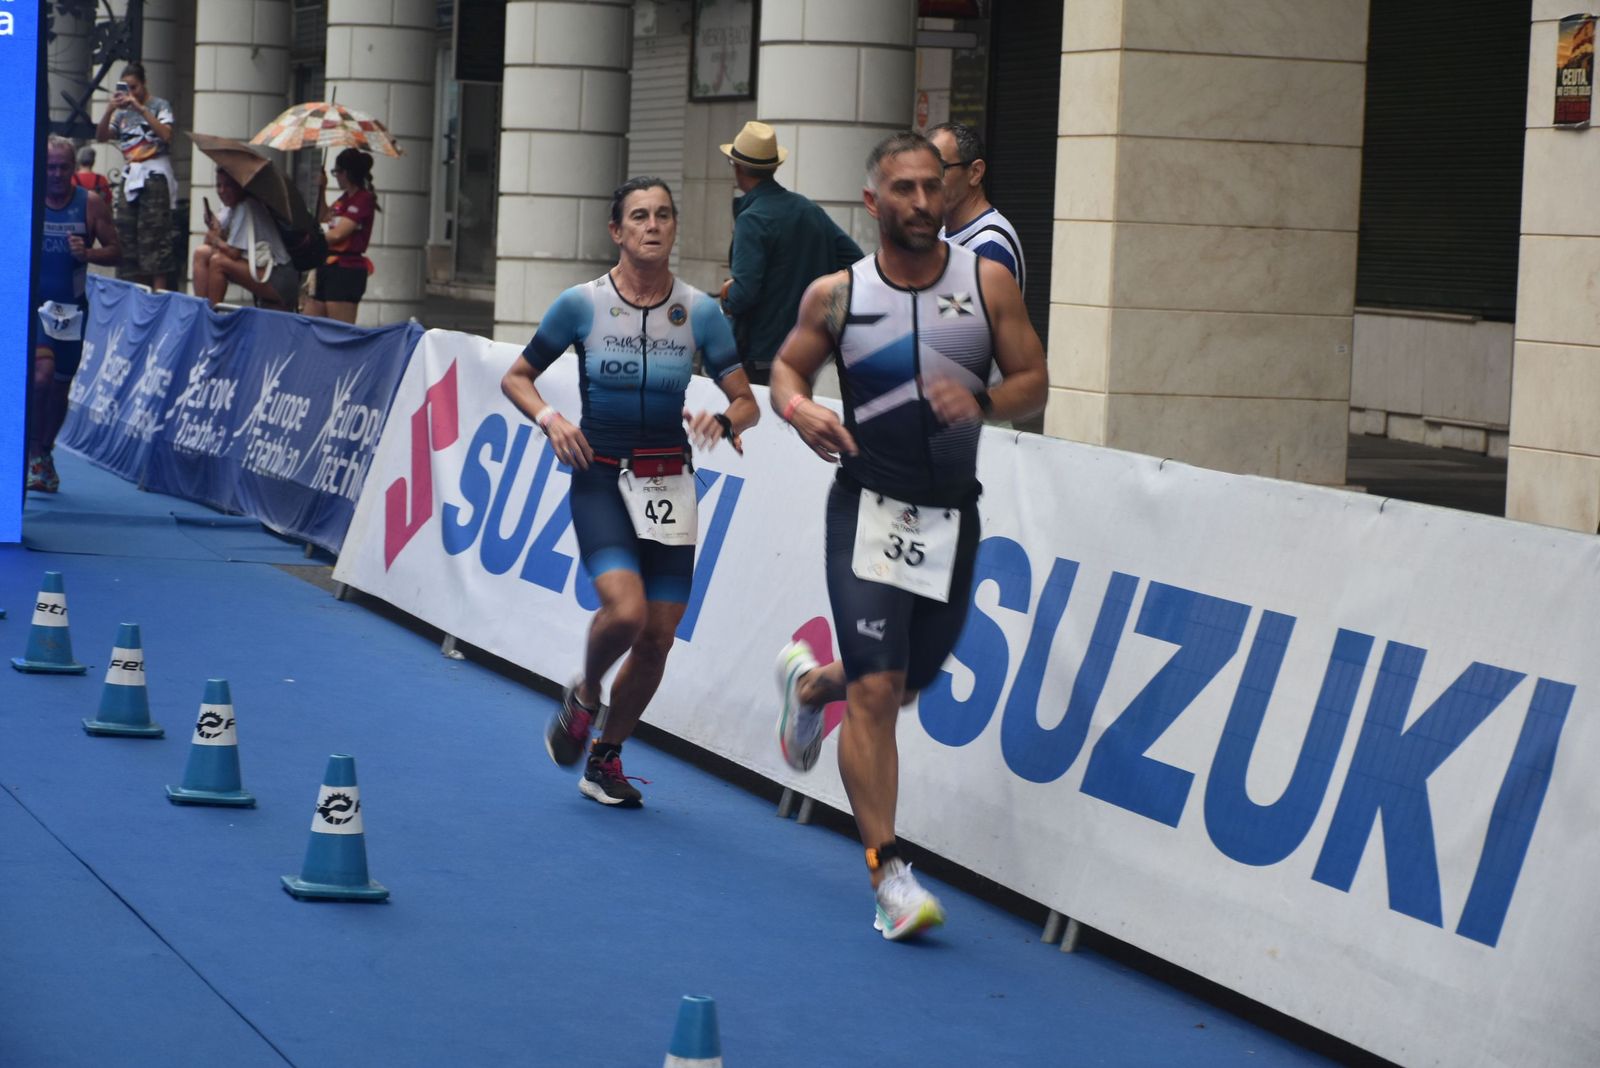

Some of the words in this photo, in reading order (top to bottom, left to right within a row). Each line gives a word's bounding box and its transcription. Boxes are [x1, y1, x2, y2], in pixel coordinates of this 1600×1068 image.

[600, 360, 640, 375] IOC
[260, 379, 311, 434] Europe
[328, 392, 384, 452] Europ
[441, 413, 745, 643] SUZI
[645, 499, 676, 524] 42
[884, 533, 925, 567] 35
[918, 536, 1577, 949] SUZUKI
